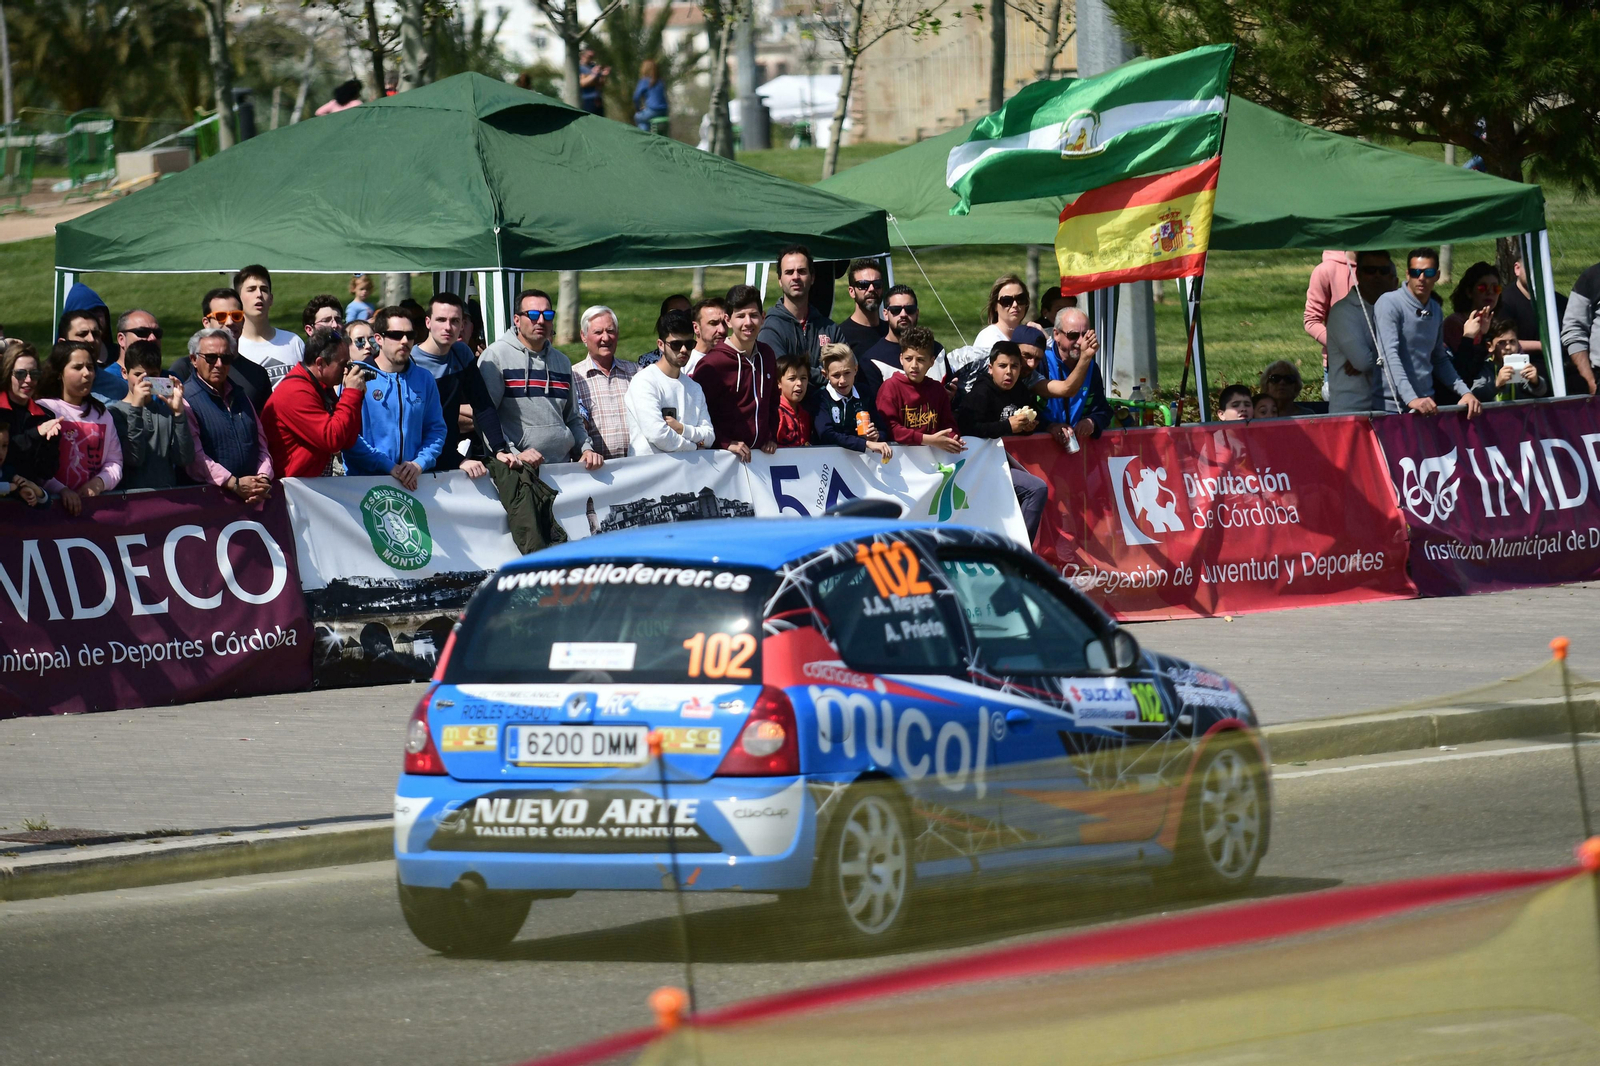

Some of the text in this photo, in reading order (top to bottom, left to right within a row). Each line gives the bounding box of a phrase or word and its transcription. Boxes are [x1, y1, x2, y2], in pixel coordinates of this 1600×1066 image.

[816, 463, 830, 510] 1969-2019
[1183, 467, 1291, 501] Diputación
[363, 489, 414, 511] ESCUDERIA
[1192, 500, 1300, 529] de Córdoba
[382, 548, 429, 567] MONTORO
[1424, 539, 1483, 561] Instituto
[1486, 531, 1562, 560] Municipal
[1566, 530, 1586, 551] de
[497, 563, 752, 592] www.stiloferrer.es
[855, 540, 934, 599] 102
[1062, 549, 1385, 594] Delegación de Juventud y Deportes
[889, 592, 935, 615] Reyes
[884, 618, 946, 642] A. Prieto
[0, 625, 297, 677] nicipal de Deportes Córdoba
[683, 632, 758, 679] 102
[803, 662, 868, 688] colchones
[461, 704, 502, 721] ROBLES
[506, 705, 551, 721] CASADO
[1131, 682, 1166, 723] 102
[527, 732, 584, 756] 6200
[592, 732, 638, 756] DMM
[808, 677, 990, 800] micol
[472, 798, 700, 825] NUEVO ARTE
[473, 826, 700, 838] TALLER DE CHAPA Y PINTURA
